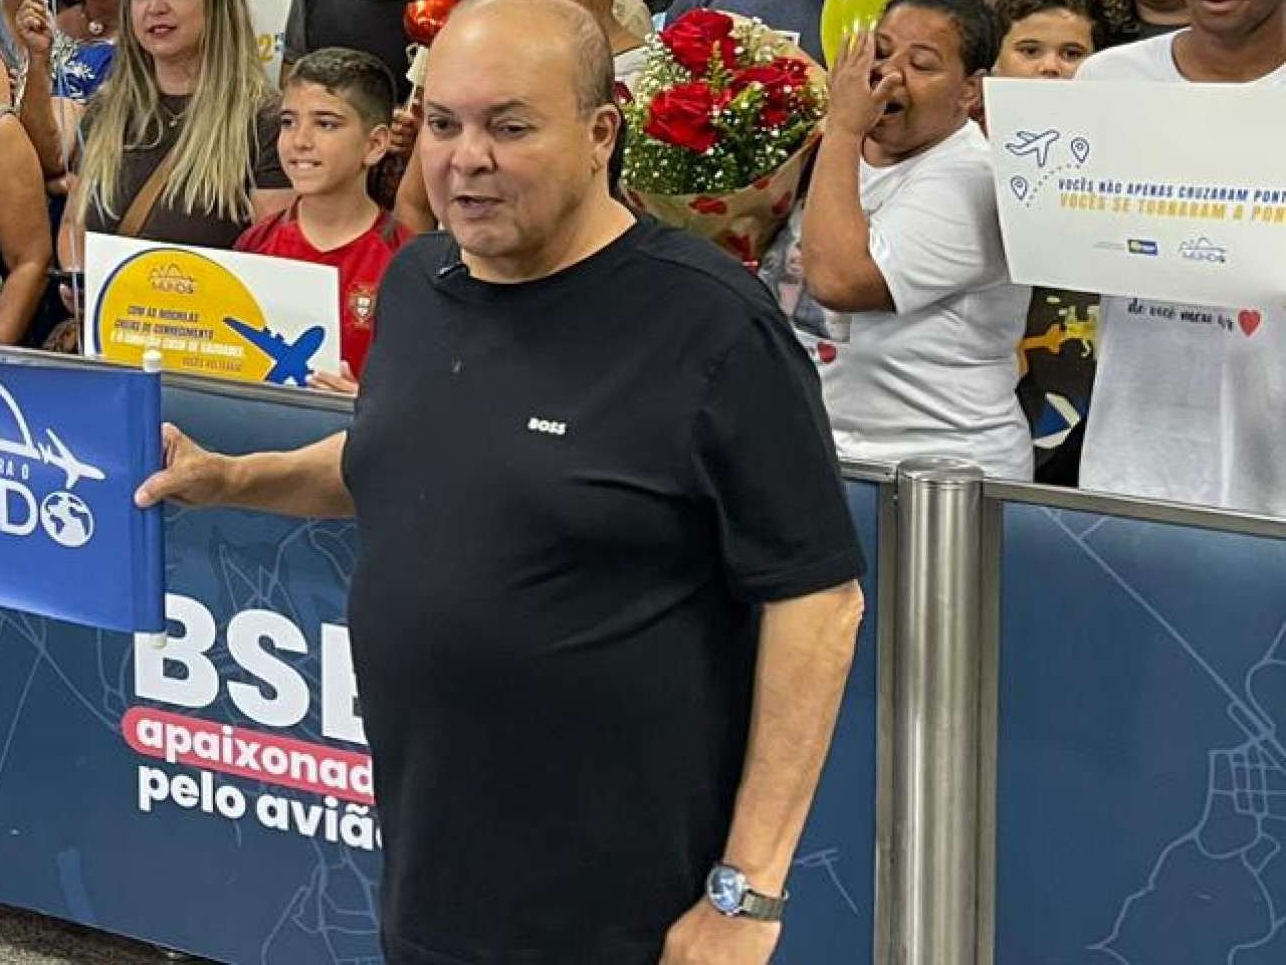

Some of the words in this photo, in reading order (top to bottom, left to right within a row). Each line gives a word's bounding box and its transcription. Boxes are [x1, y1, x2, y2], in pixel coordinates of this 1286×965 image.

[1058, 176, 1094, 194] VOCÊS
[1098, 178, 1123, 195] NÃO
[1126, 183, 1173, 199] APENAS
[1178, 186, 1249, 201] CRUZARAM
[527, 417, 566, 435] BOSS
[22, 463, 30, 480] O
[138, 765, 246, 819] pelo
[256, 794, 383, 851] aviã
